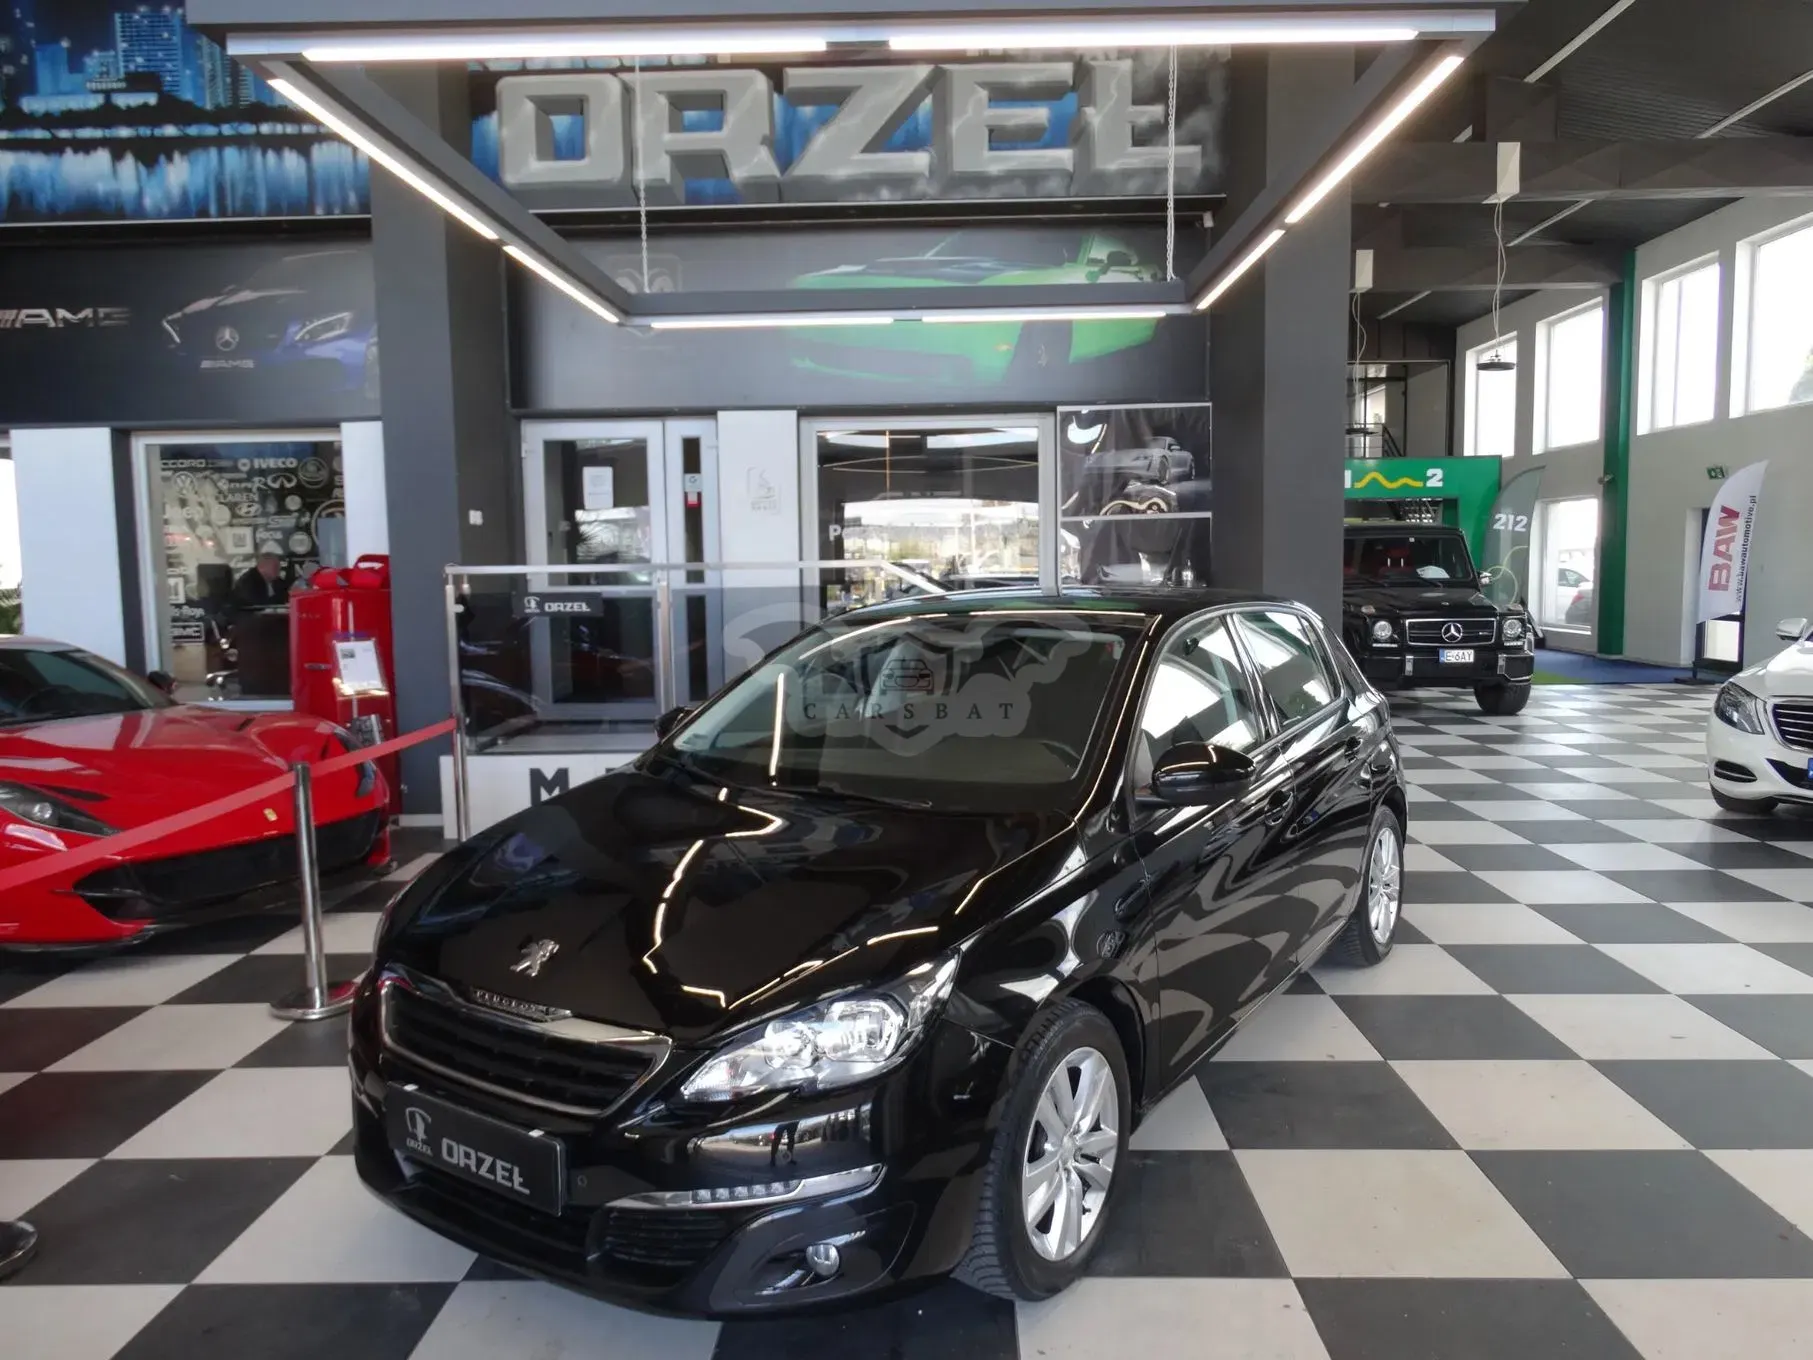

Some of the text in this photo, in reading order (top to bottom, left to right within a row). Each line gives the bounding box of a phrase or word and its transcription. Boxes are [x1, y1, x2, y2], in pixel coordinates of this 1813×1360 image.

[496, 60, 1204, 203] ORZEŁ
[253, 457, 298, 469] IVECO
[1426, 468, 1443, 487] 2
[1493, 514, 1528, 532] 212
[1708, 505, 1740, 591] BAW
[442, 1137, 530, 1195] ORZEŁ
